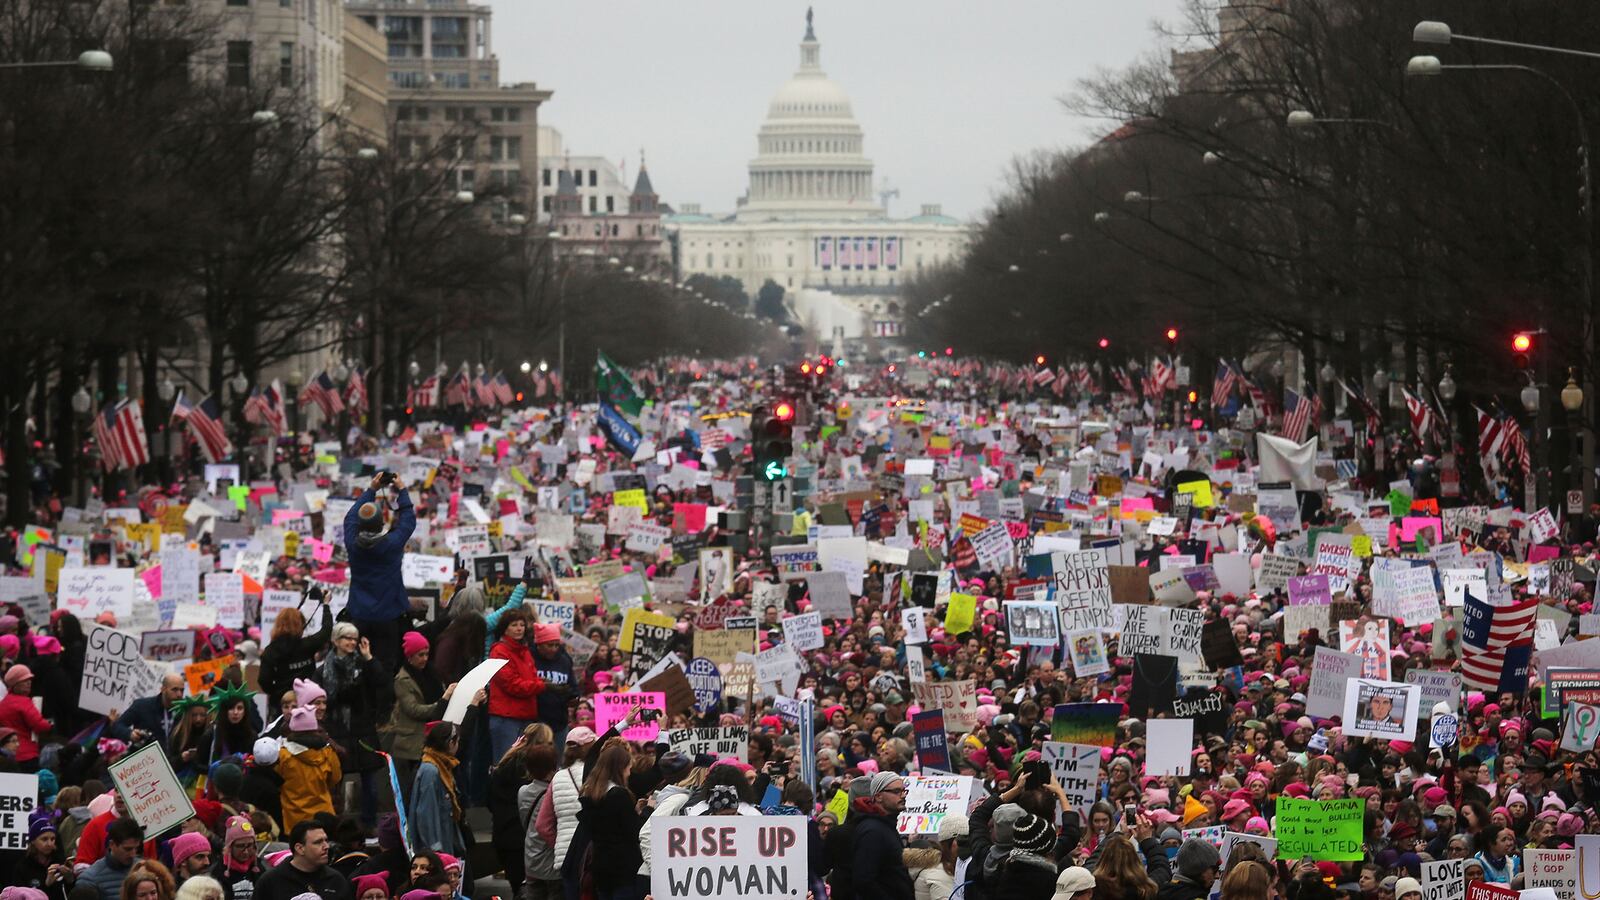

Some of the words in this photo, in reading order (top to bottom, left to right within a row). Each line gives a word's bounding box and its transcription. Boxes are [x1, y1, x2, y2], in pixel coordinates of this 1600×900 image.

[772, 551, 818, 566] STRONGER
[1064, 551, 1100, 571] KEEP
[1055, 566, 1110, 592] RAPISTS
[1296, 577, 1319, 589] Yes
[1060, 591, 1089, 609] OFF
[1091, 588, 1111, 608] MY
[1062, 607, 1115, 631] CAMPUS
[1126, 604, 1149, 622] WE
[634, 623, 674, 640] STOP
[1122, 621, 1146, 634] ARE
[89, 627, 139, 662] GOD
[1122, 633, 1160, 649] CITIZENS
[1170, 636, 1199, 655] BACK
[690, 659, 714, 675] KEEP
[1316, 652, 1350, 667] WOMEN'S
[1315, 662, 1345, 674] RIGHTS
[1430, 676, 1447, 686] BODY
[959, 682, 974, 697] WE
[669, 727, 693, 746] KEEP
[694, 727, 719, 741] YOUR
[723, 726, 748, 742] LAWS
[689, 743, 709, 756] OFF
[716, 741, 738, 754] OUR
[1054, 759, 1078, 772] I'M
[1065, 794, 1084, 806] ER
[1320, 801, 1359, 812] VAGINA
[1329, 812, 1361, 822] BULLETS
[668, 827, 737, 858] RISE
[757, 826, 797, 858] UP
[1428, 860, 1463, 882] LOVE
[1543, 864, 1564, 873] GOP
[667, 864, 798, 897] WOMAN.
[1531, 879, 1564, 888] HANDS
[1423, 884, 1444, 900] NOT
[1445, 879, 1463, 898] HATE
[1471, 886, 1490, 900] THIS
